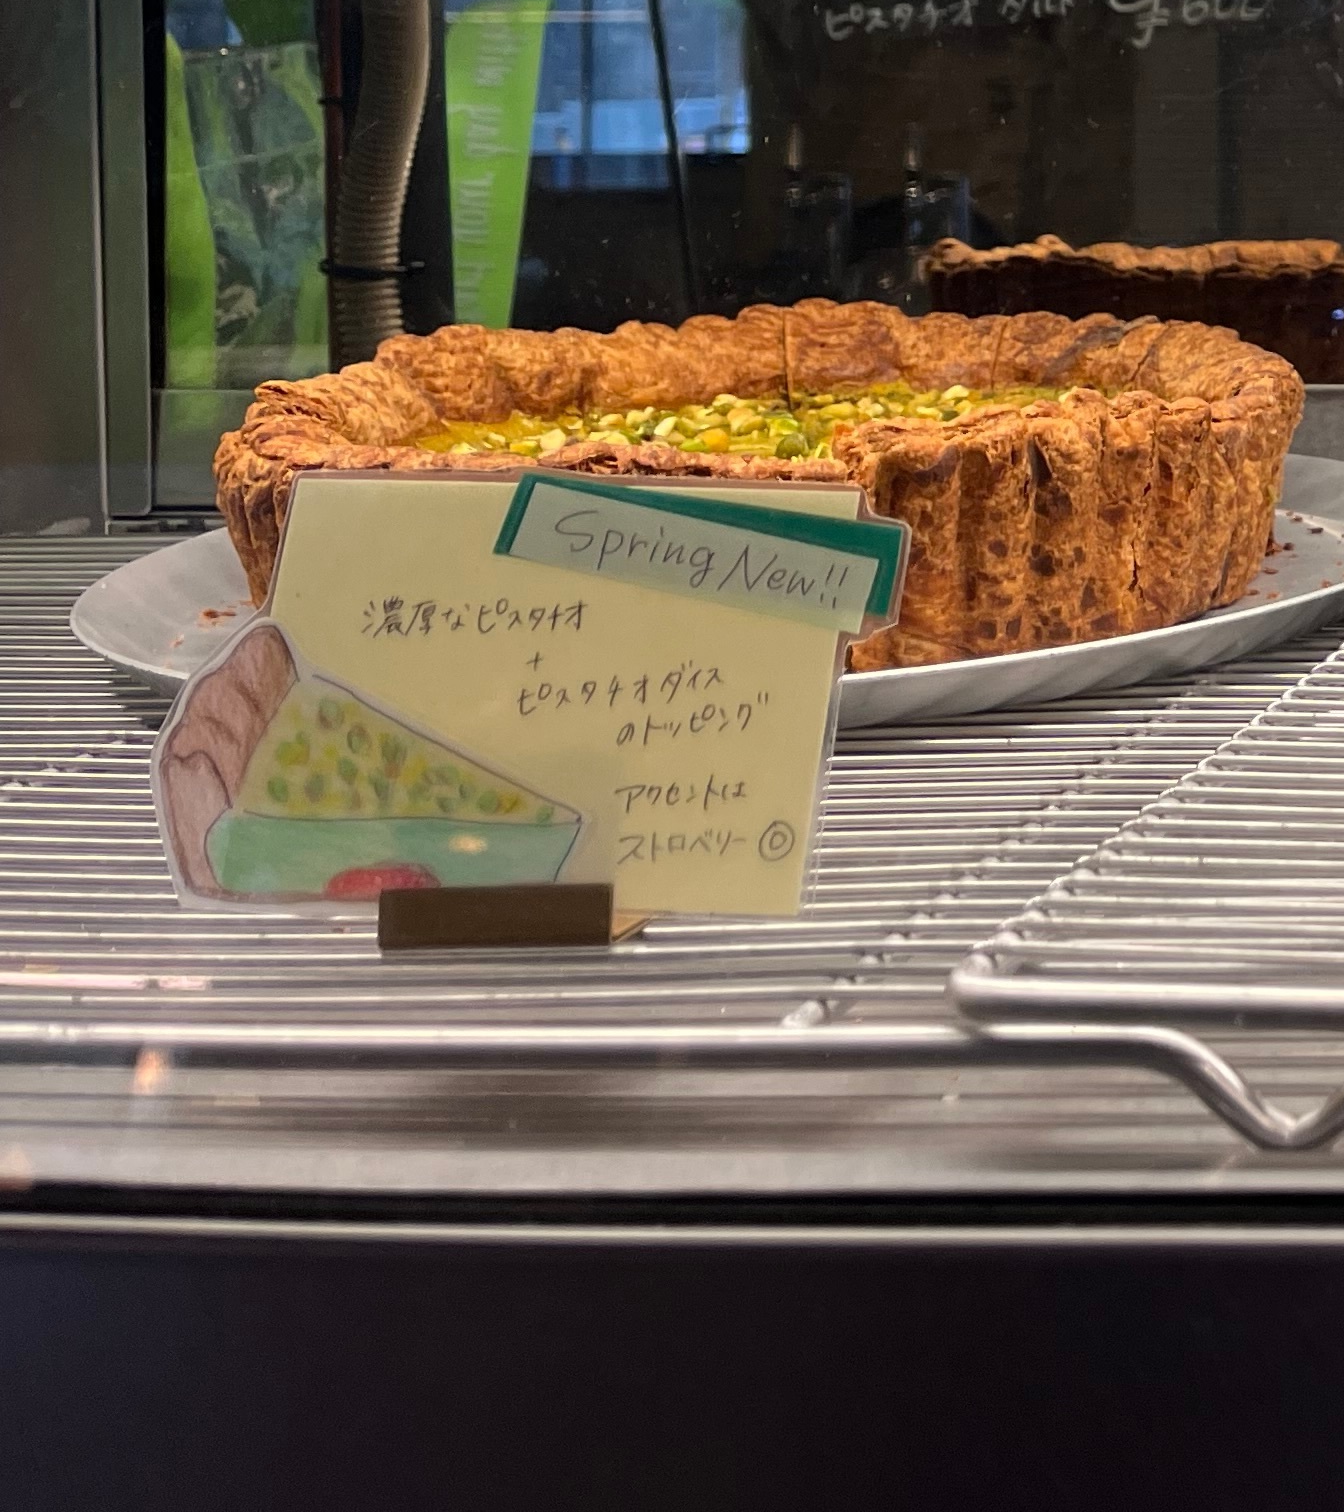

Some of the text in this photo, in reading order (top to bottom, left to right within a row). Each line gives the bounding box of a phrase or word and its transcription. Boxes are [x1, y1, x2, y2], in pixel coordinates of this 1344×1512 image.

[554, 509, 849, 610] Spring New!!
[360, 594, 589, 639] 濃厚なピスタチオ
[615, 690, 770, 747] のトッピング
[613, 773, 747, 814] アクセントは
